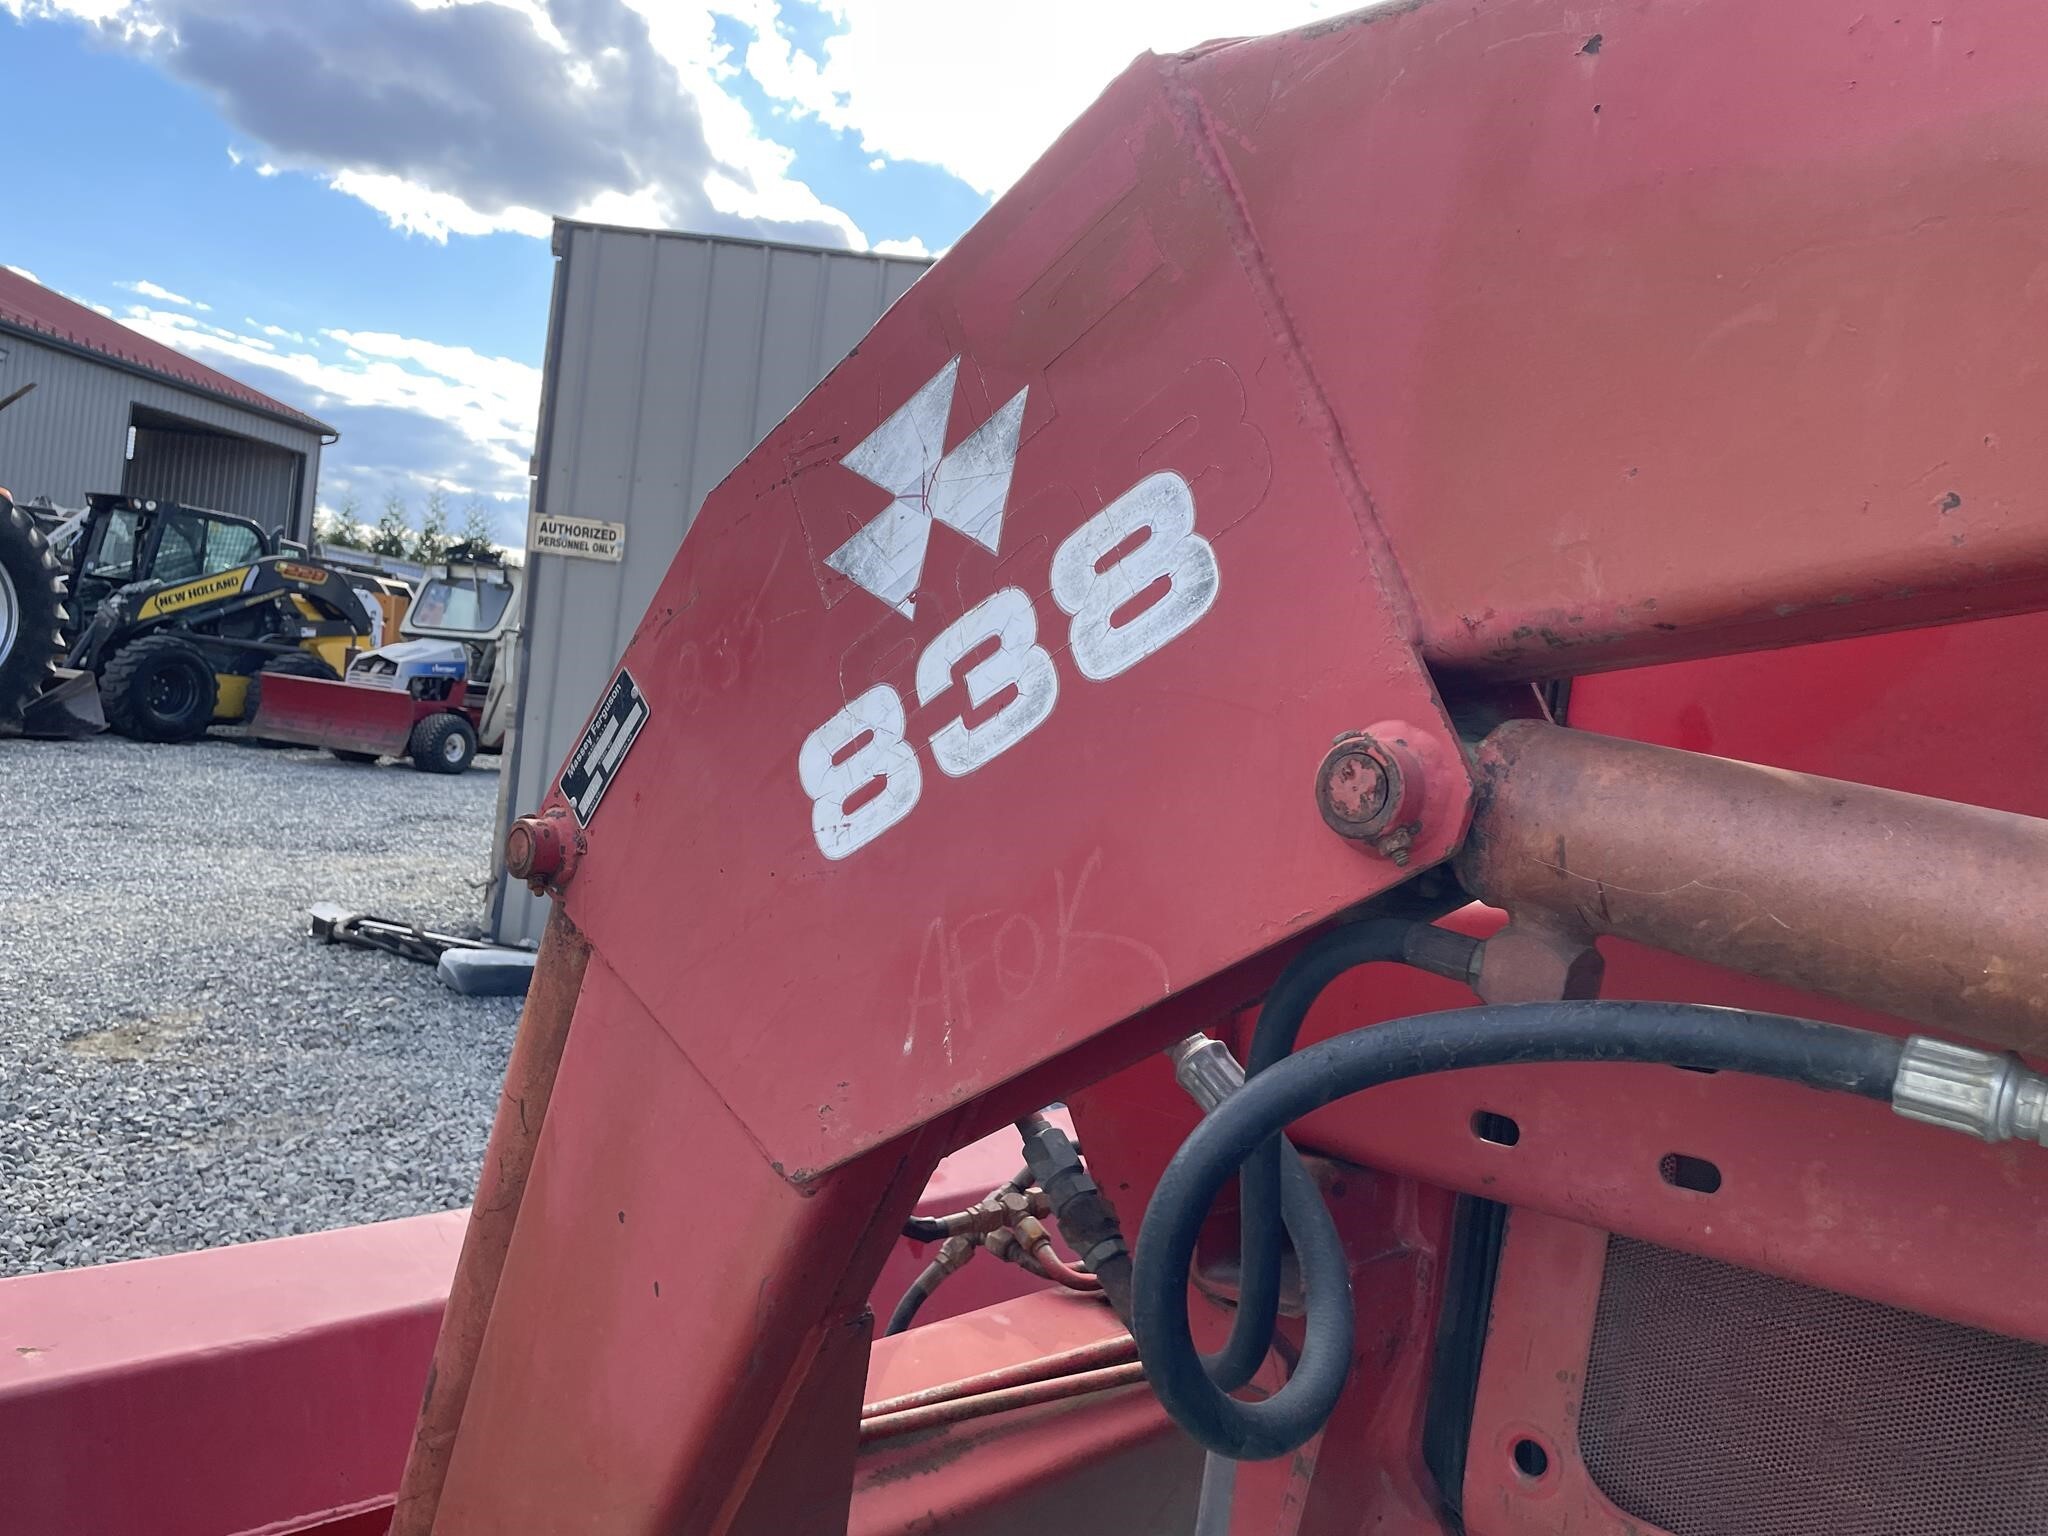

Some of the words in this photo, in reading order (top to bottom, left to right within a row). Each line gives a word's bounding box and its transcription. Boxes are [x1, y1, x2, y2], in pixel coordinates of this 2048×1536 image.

[538, 535, 590, 551] PERSONNEL
[593, 542, 616, 554] ONLY
[540, 521, 617, 541] AUTHORIZED
[159, 591, 186, 607] NEW
[188, 576, 240, 599] HOLLAND
[798, 469, 1220, 861] 838
[567, 735, 593, 779] Massey
[590, 682, 622, 736] Ferguson
